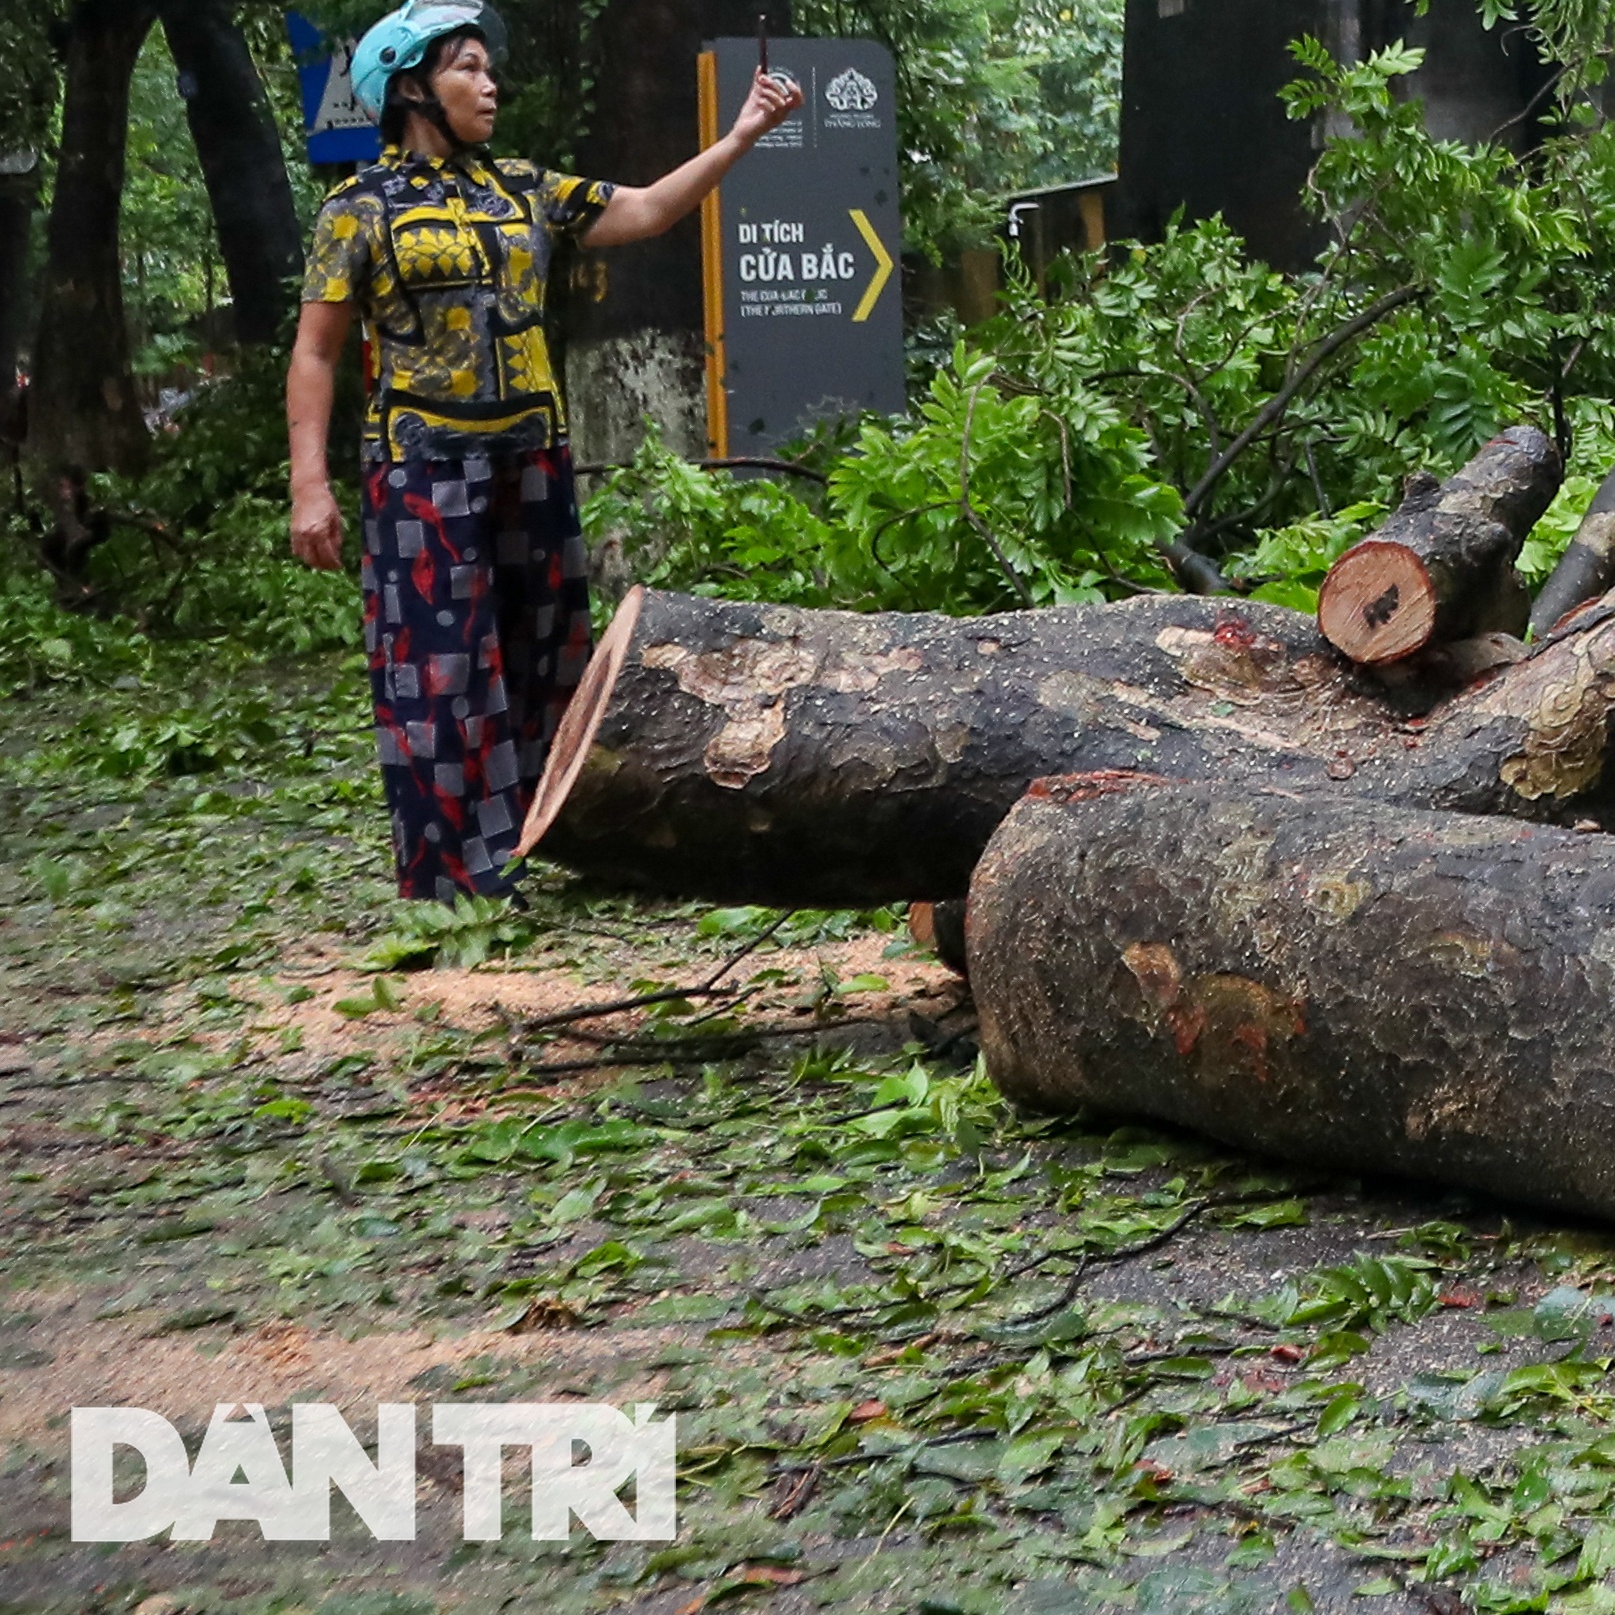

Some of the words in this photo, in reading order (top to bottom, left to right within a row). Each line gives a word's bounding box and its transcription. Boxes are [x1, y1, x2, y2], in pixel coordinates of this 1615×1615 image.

[738, 222, 758, 244] DI
[761, 218, 805, 244] TÍCH
[739, 246, 795, 283] CỬA
[801, 242, 856, 281] BẮC
